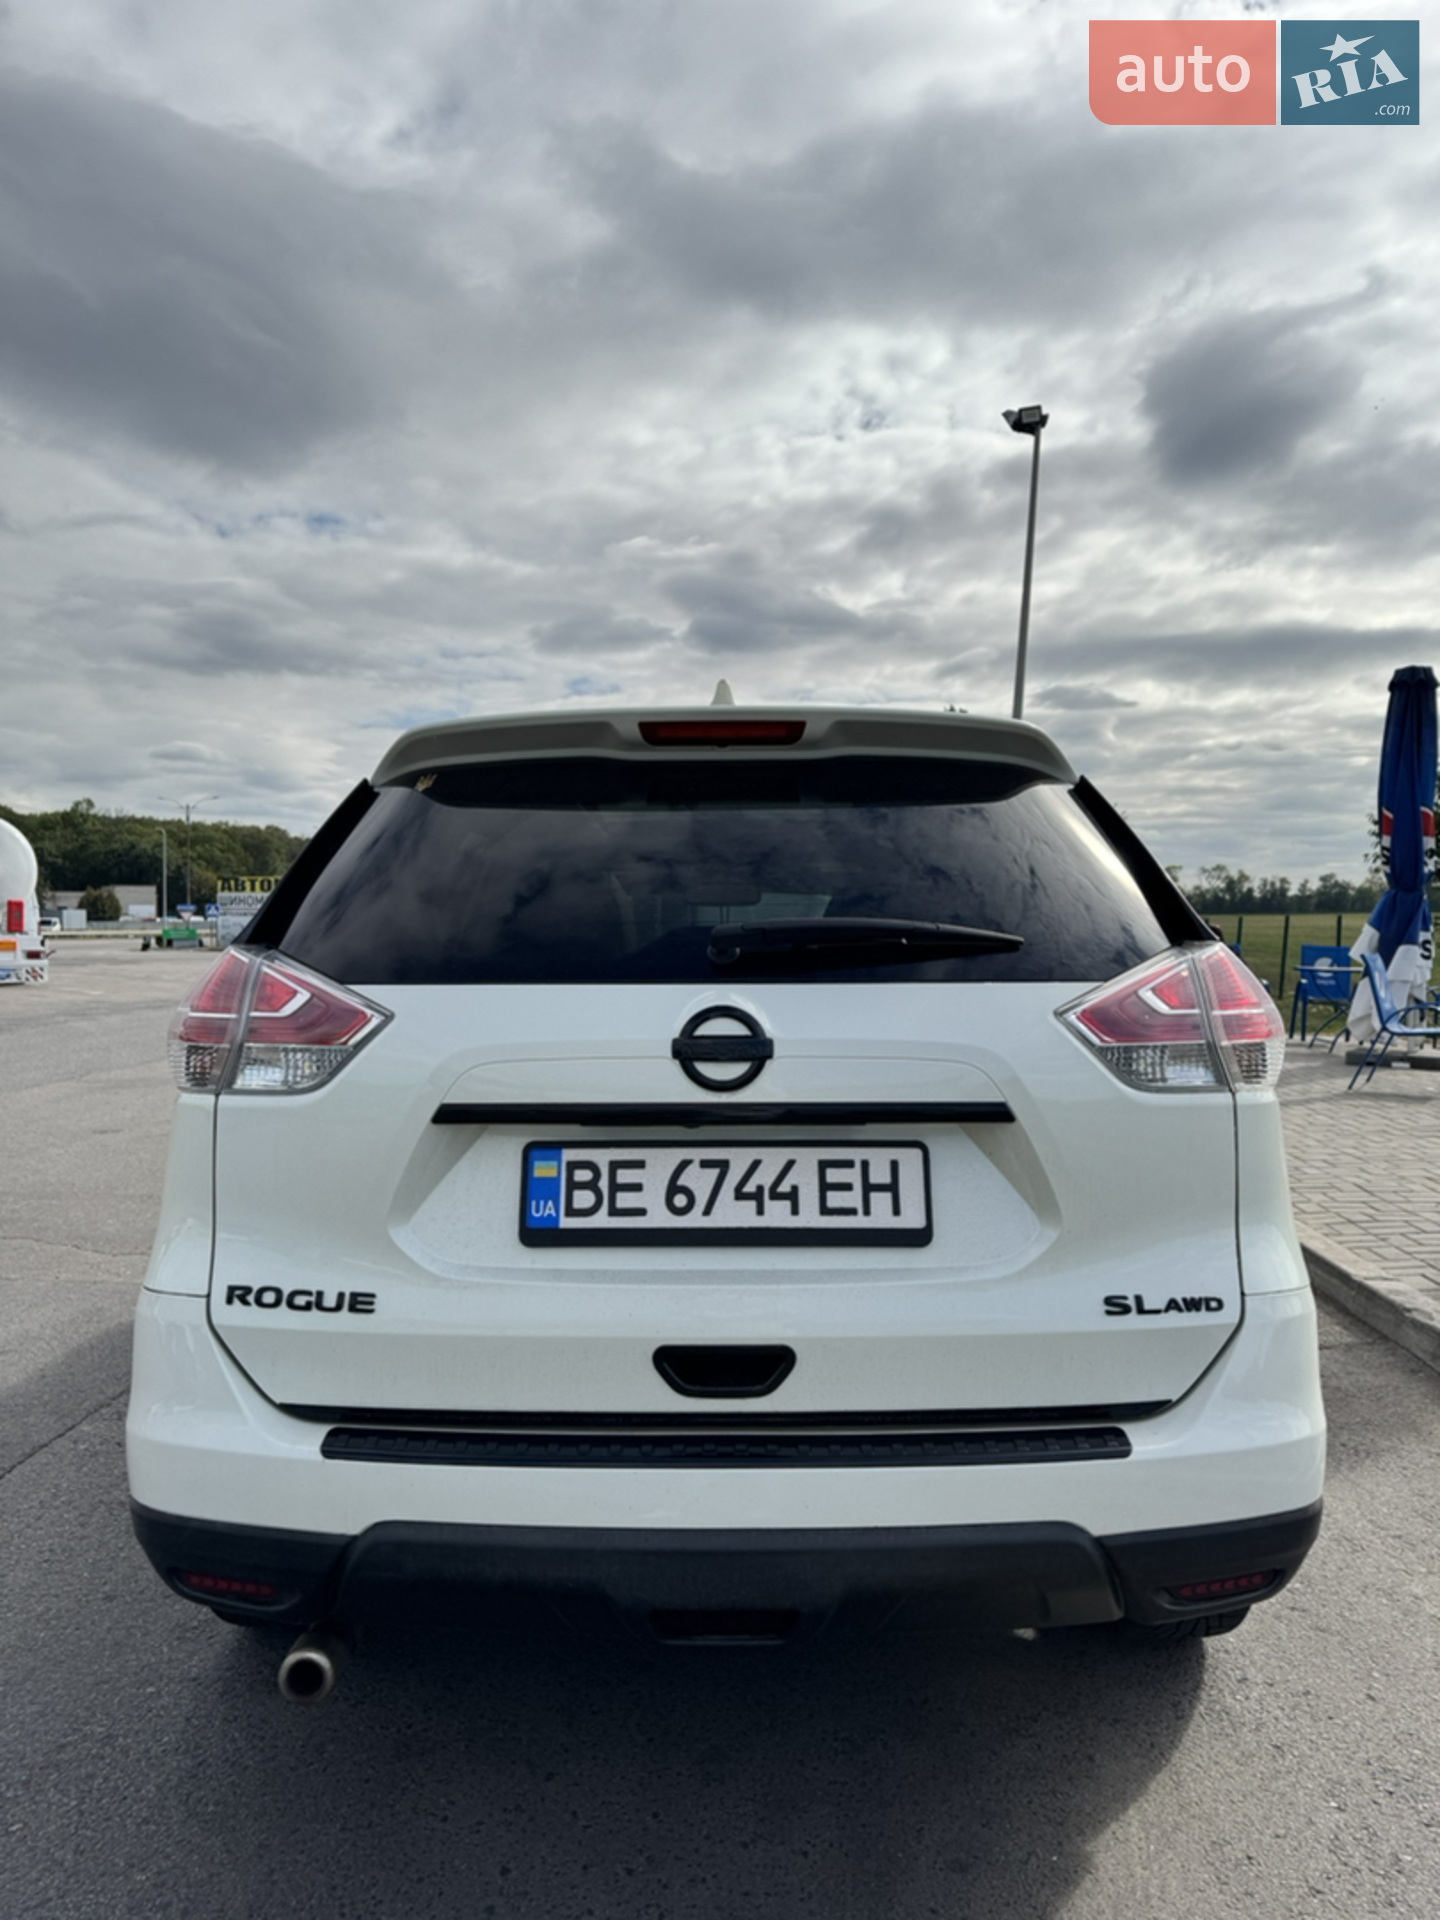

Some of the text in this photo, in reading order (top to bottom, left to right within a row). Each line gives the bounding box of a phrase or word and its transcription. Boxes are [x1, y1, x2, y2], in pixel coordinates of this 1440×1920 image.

[564, 1159, 901, 1218] BE 6744 EH
[531, 1199, 557, 1217] UA
[225, 1284, 377, 1314] ROGUE
